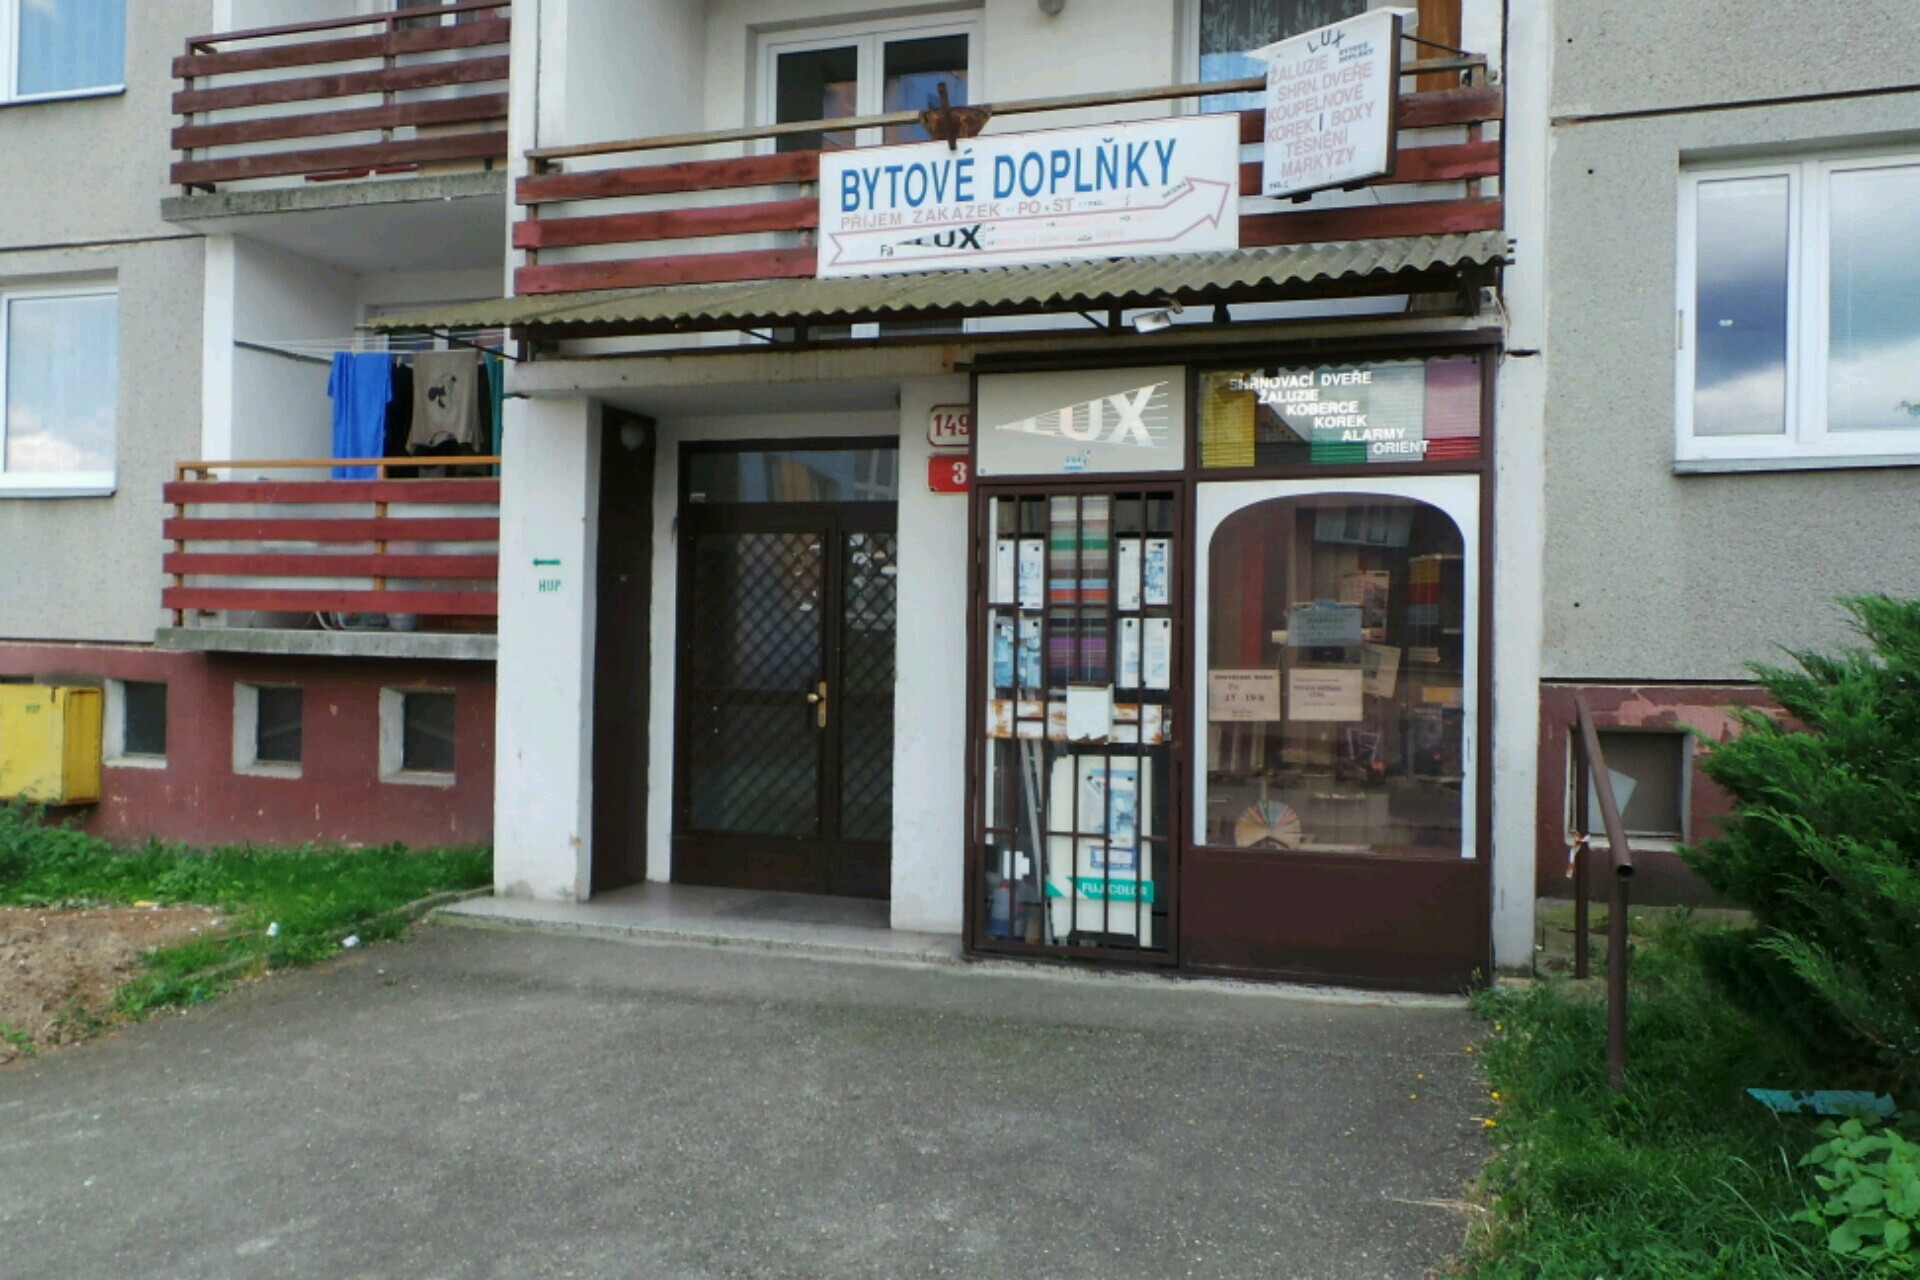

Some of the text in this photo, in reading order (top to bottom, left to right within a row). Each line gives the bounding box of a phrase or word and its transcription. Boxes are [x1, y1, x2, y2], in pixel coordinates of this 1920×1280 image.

[1330, 100, 1375, 127] BOXY
[840, 137, 1176, 212] BYTOVÉ DOPLŇKY
[880, 244, 894, 257] Fa
[1320, 370, 1373, 385] DVEŘE
[1285, 401, 1359, 416] KOBERCE
[1312, 414, 1368, 429] KOREK
[1341, 427, 1406, 442] ALARMY
[1371, 440, 1430, 455] ORIENT
[952, 461, 967, 484] 3
[538, 579, 562, 592] HUP
